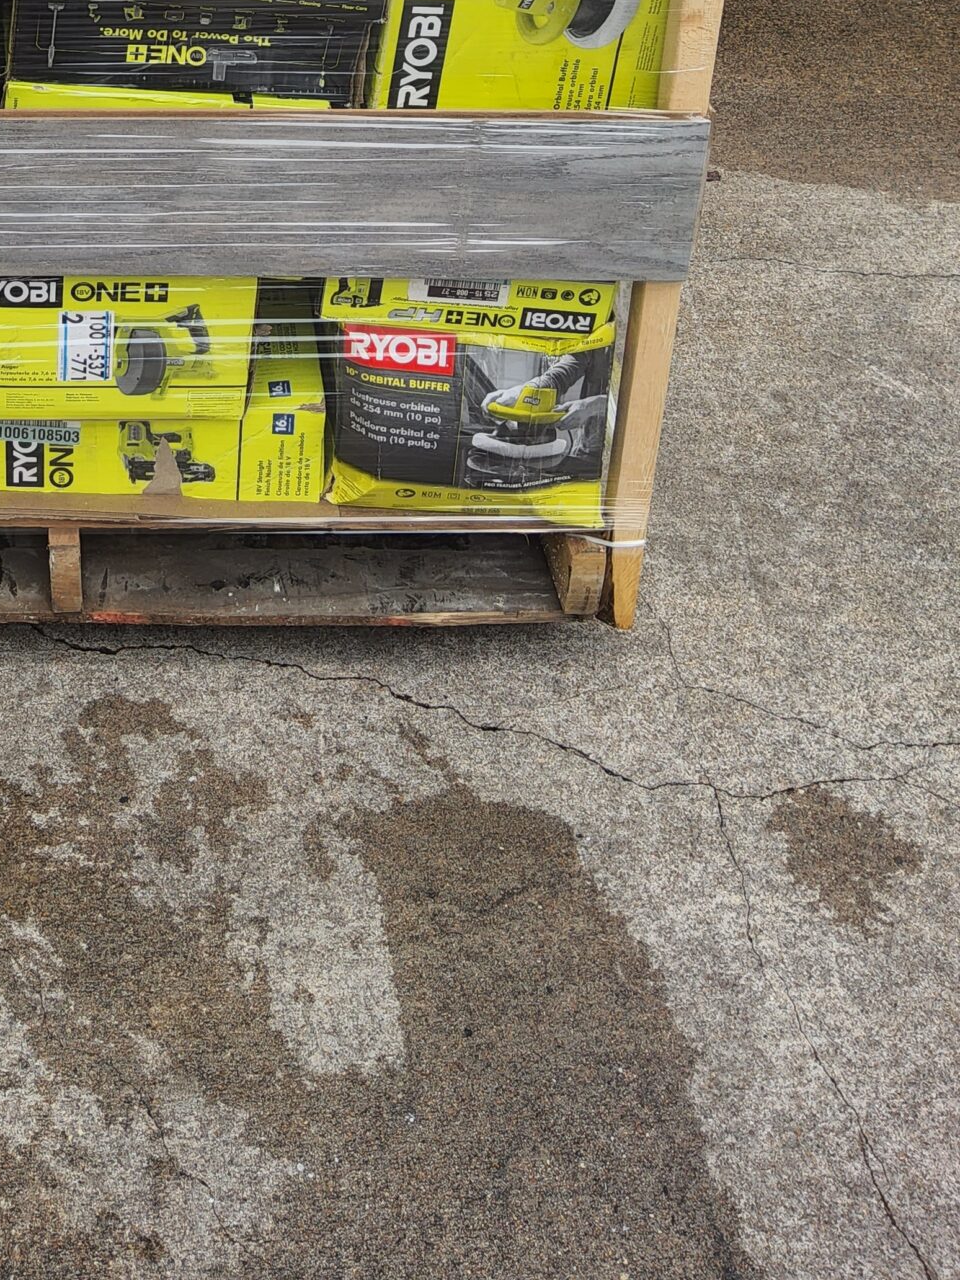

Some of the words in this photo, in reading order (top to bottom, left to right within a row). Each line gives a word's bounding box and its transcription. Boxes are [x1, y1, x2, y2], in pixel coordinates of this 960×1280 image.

[298, 0, 321, 8] Cleaning
[98, 27, 143, 40] More.
[148, 30, 168, 41] Do
[126, 45, 207, 67] ONE+
[397, 5, 444, 109] RYOBI
[570, 59, 580, 87] orbitale
[554, 84, 564, 110] Orbital
[559, 59, 569, 81] Buffer
[72, 282, 169, 302] ONE+
[517, 287, 538, 298] NOM
[62, 314, 83, 324] 2
[388, 308, 441, 322] HP
[446, 310, 515, 328] ONE+
[524, 313, 590, 331] RYOBI
[88, 316, 106, 378] 1001-537
[348, 332, 448, 366] RYOBI
[272, 386, 283, 395] 16
[361, 373, 406, 388] ORBITAL
[410, 379, 450, 392] BUFFER
[351, 388, 398, 407] Lustreuse
[400, 401, 440, 413] orbitale
[350, 397, 360, 407] de
[362, 401, 381, 413] 254
[383, 408, 403, 418] mm
[406, 409, 422, 420] (10
[425, 413, 441, 424] po)
[275, 420, 287, 432] 16
[350, 412, 387, 433] Pulidora
[390, 425, 423, 438] orbital
[427, 429, 439, 439] de
[350, 421, 366, 435] 254
[368, 431, 387, 442] mm
[389, 433, 405, 444] (10
[407, 437, 438, 449] pulg.)
